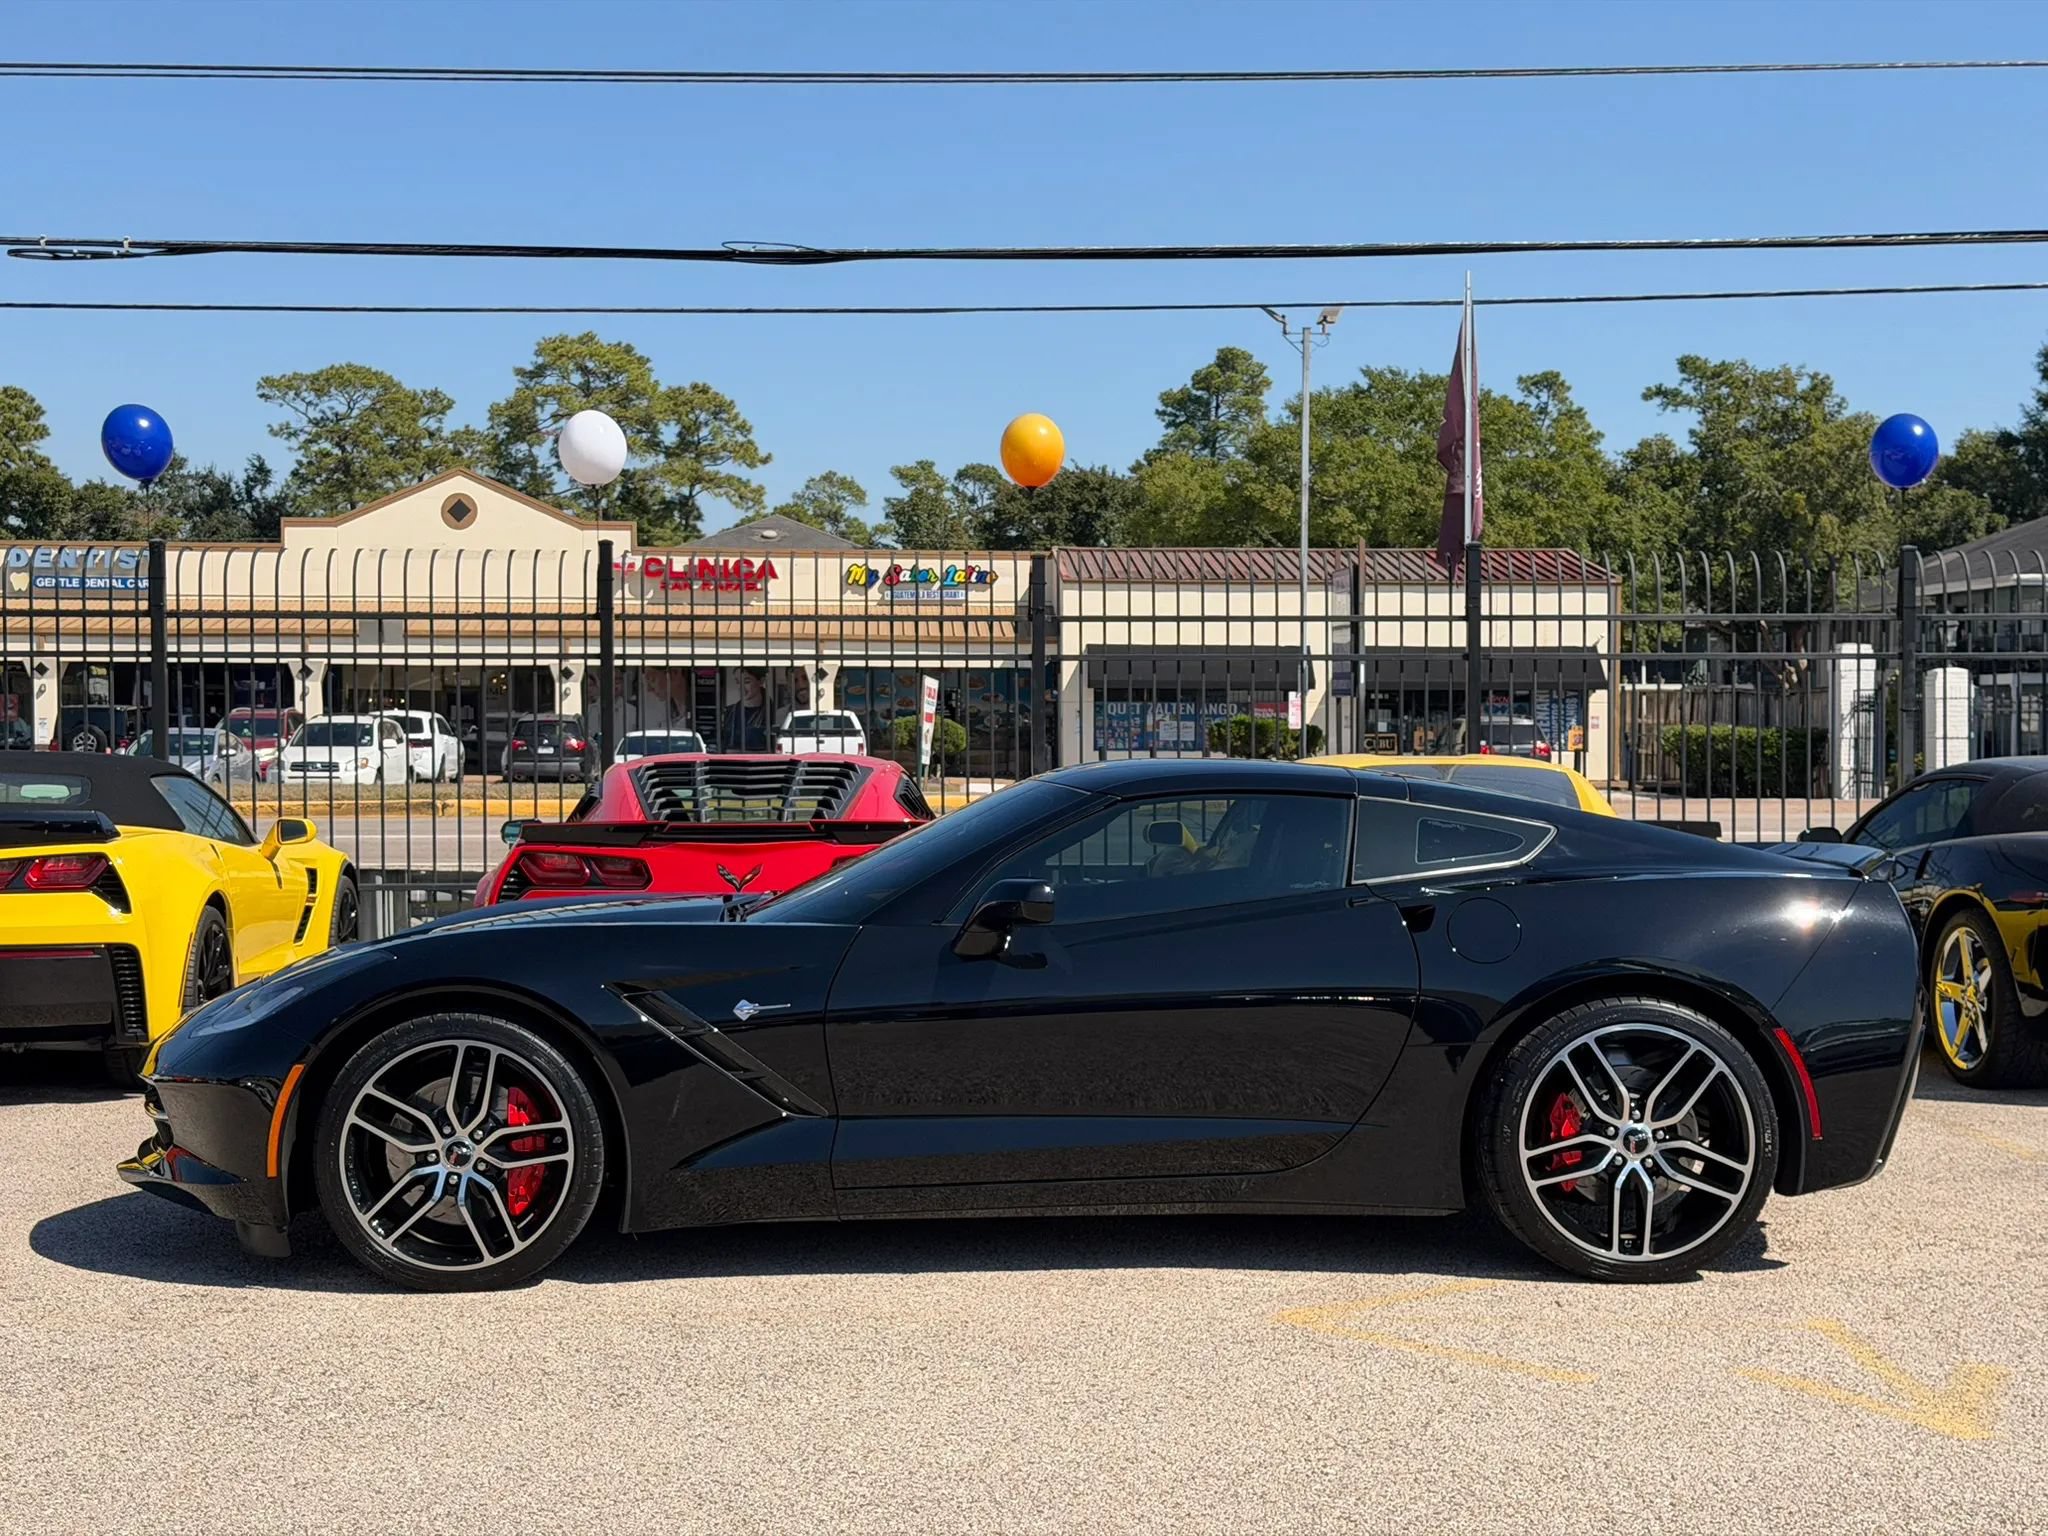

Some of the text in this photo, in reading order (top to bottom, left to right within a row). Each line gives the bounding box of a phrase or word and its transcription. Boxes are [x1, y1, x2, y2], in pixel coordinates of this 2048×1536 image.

[645, 557, 779, 579] CLINICA
[847, 563, 998, 588] My Sabor Latino
[36, 577, 149, 588] GENTLE DENTAL CAR
